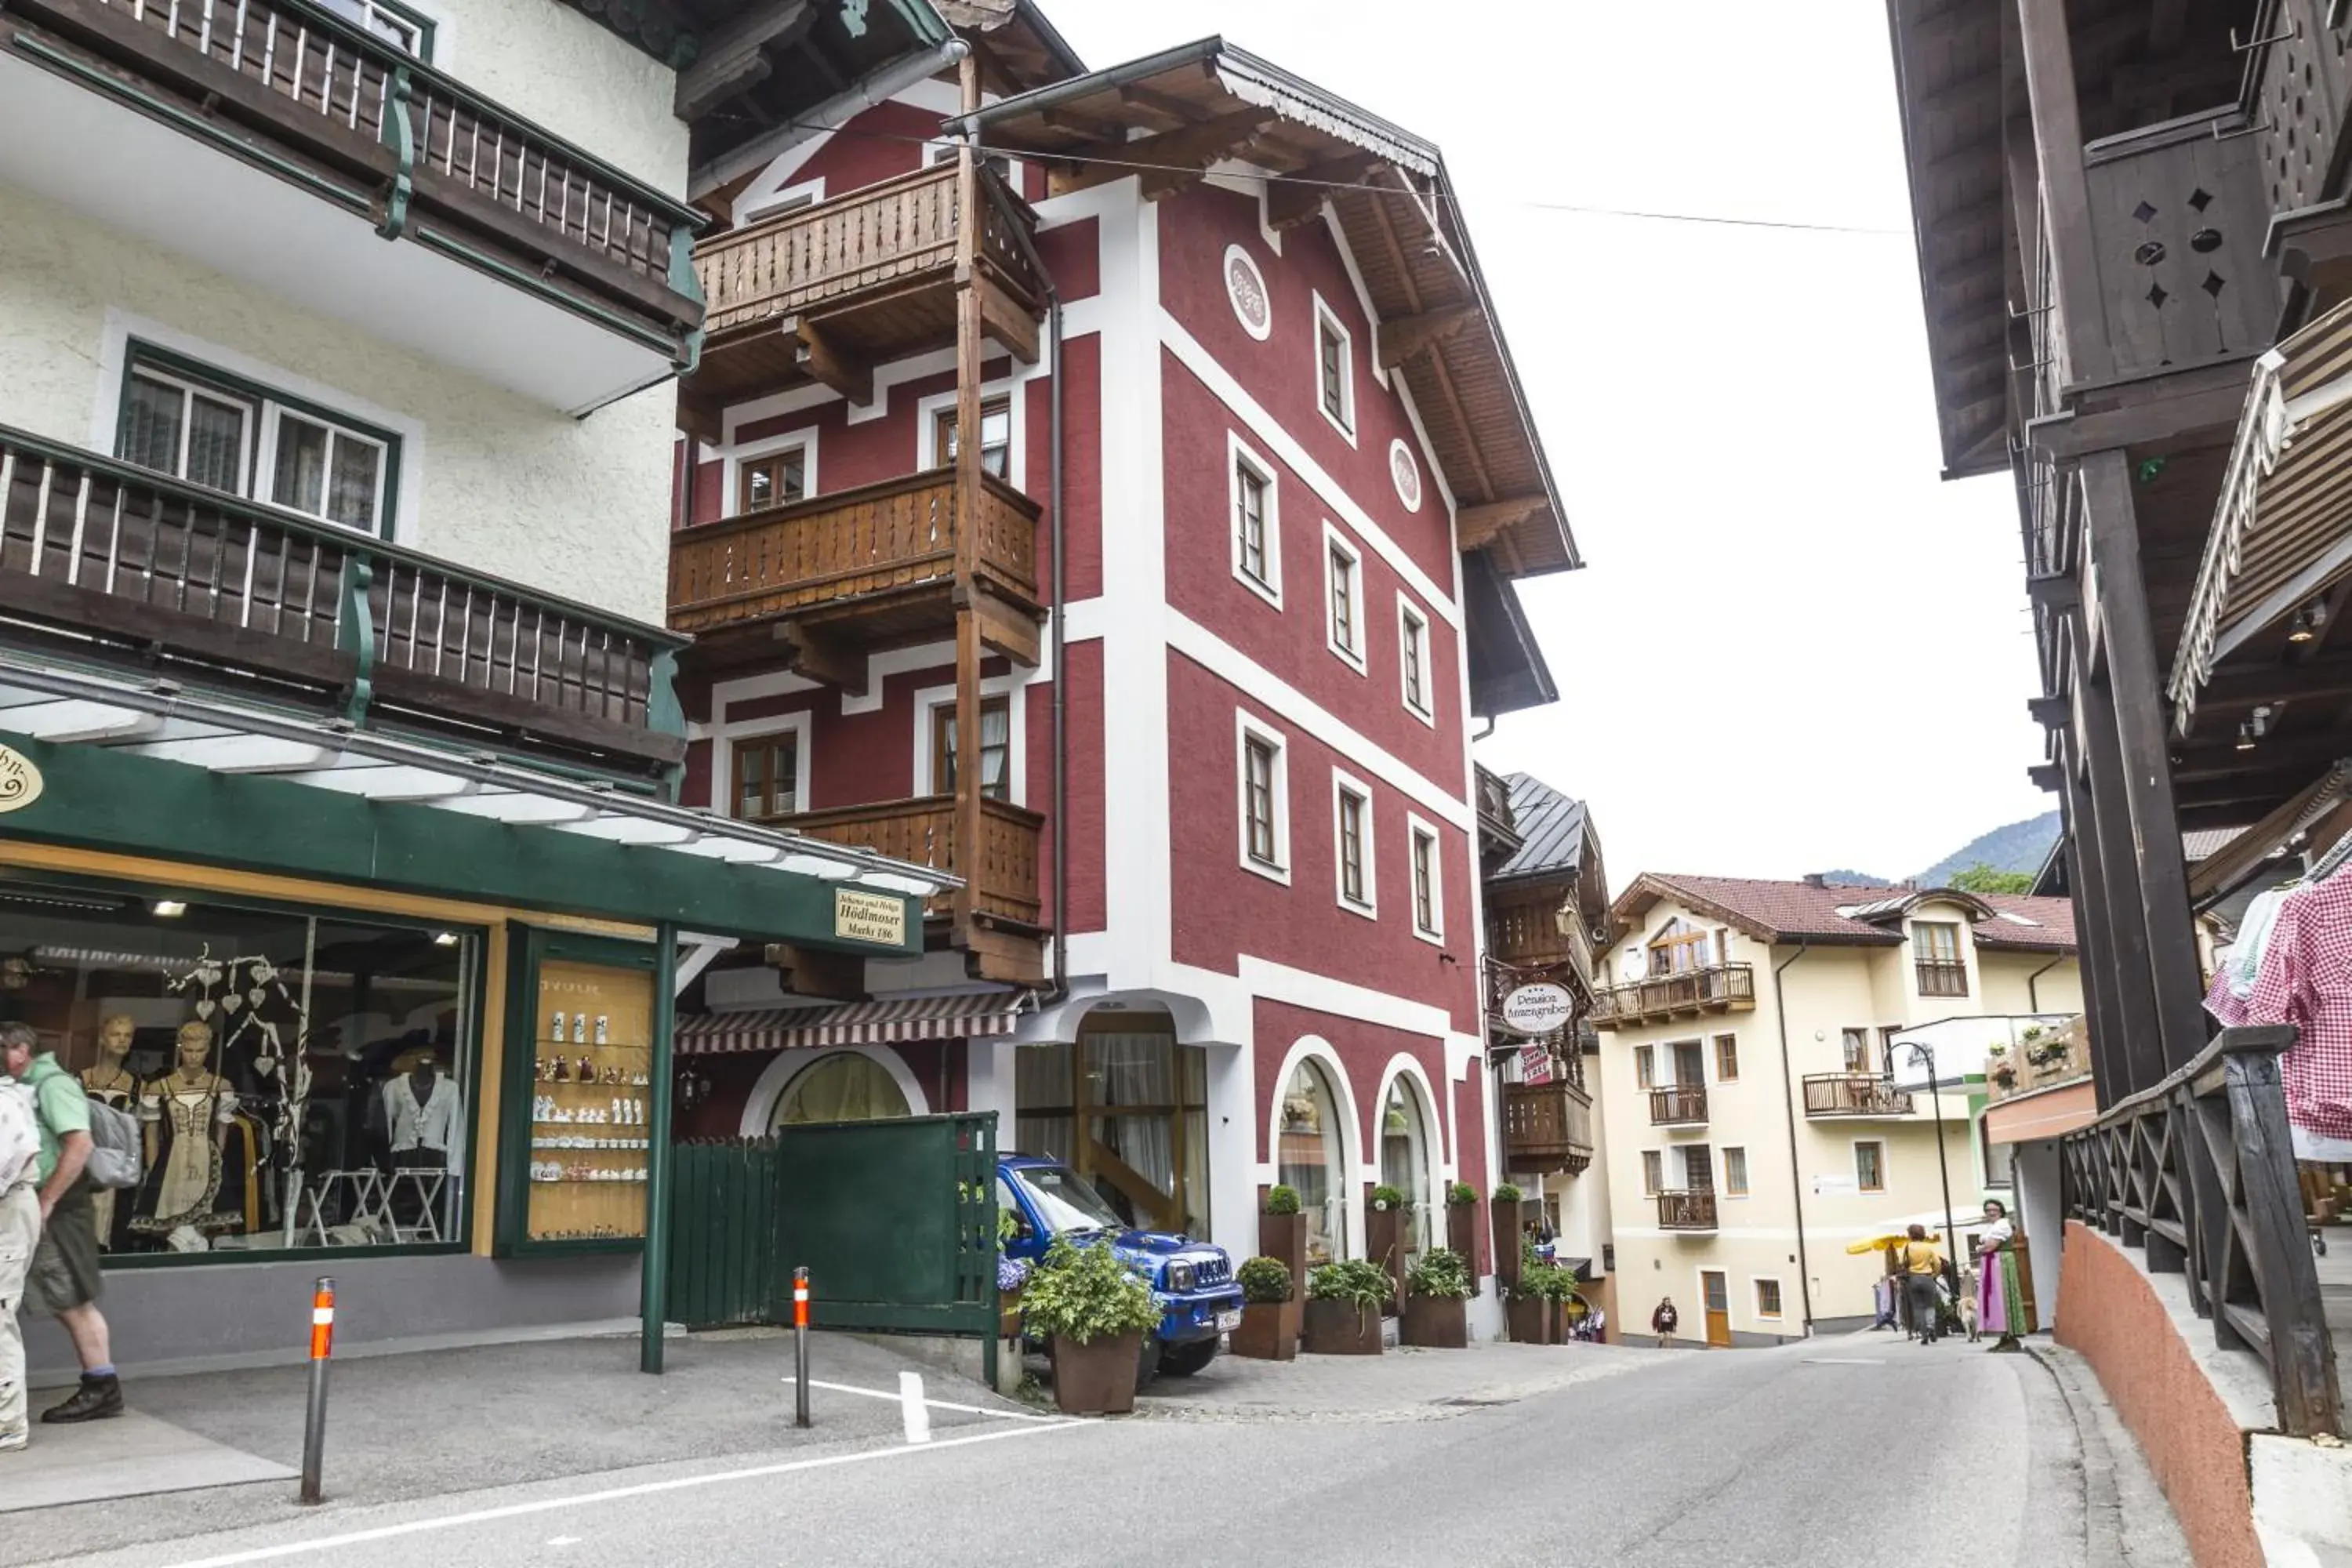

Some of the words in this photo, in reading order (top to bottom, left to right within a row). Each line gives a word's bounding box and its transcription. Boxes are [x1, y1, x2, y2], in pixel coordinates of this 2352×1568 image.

[840, 905, 900, 926] Hödlmoser
[848, 922, 874, 937] Markt
[1518, 994, 1557, 1005] Pension
